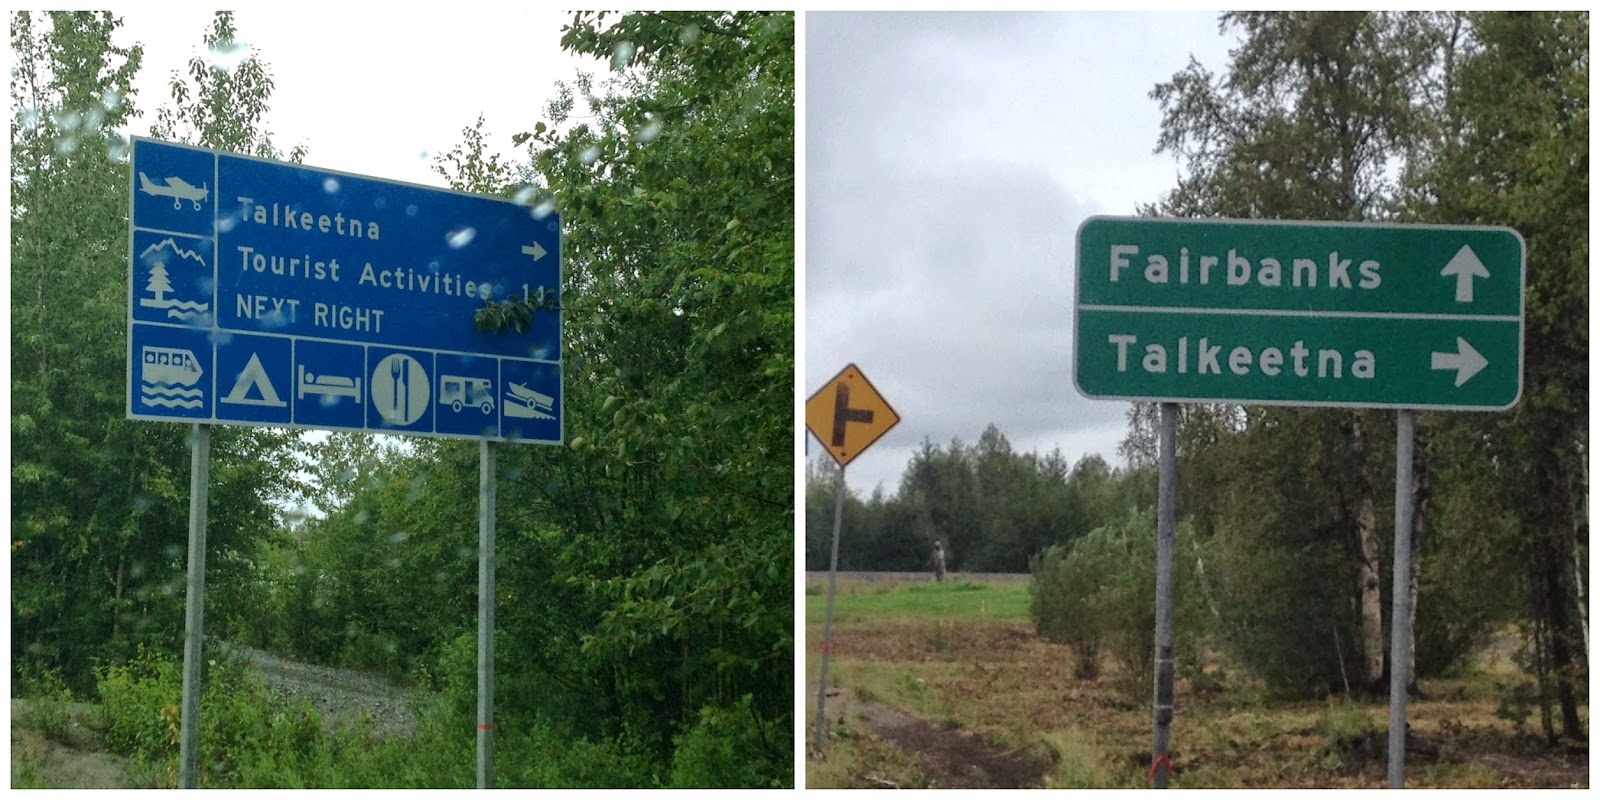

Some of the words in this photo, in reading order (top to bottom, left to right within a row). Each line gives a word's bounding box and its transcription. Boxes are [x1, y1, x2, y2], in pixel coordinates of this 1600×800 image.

[237, 196, 380, 240] Talkeetna
[237, 245, 340, 282] Tourist
[358, 262, 493, 300] Activities
[1109, 244, 1382, 290] Fairbanks
[236, 293, 300, 323] NEXT
[314, 302, 384, 333] RIGHT
[1108, 334, 1376, 379] Talkeetna
